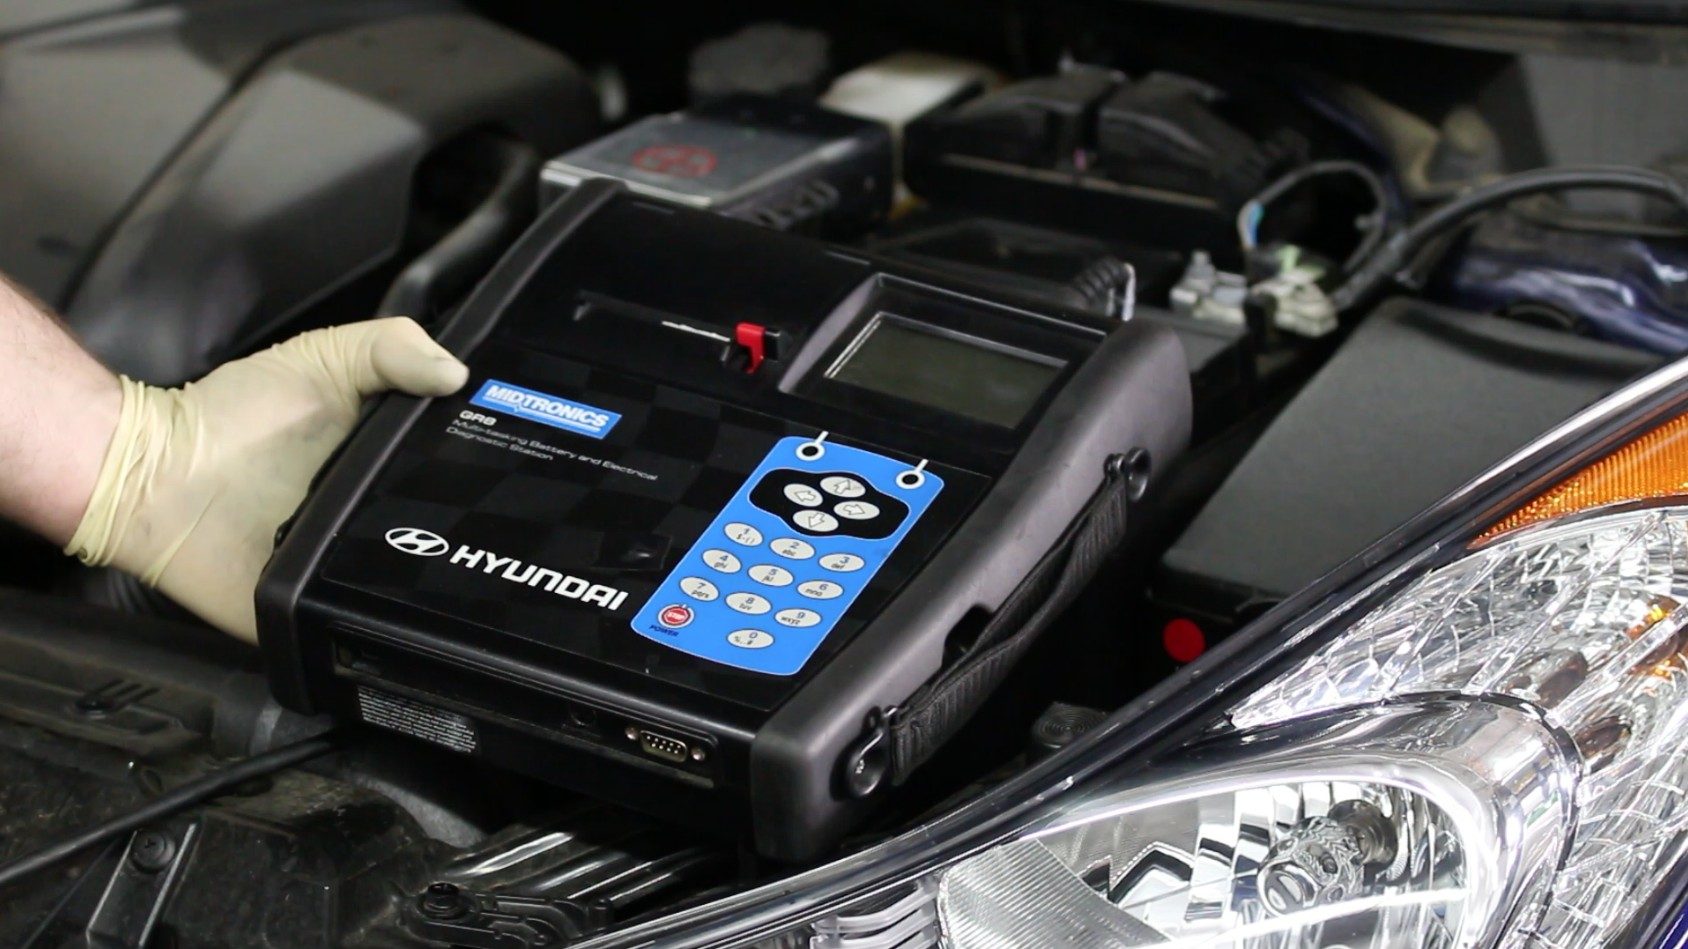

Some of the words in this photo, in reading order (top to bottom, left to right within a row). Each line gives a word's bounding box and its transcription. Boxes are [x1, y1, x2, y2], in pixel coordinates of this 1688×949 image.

[485, 385, 609, 428] MIDTRONICS
[459, 410, 497, 426] GR8
[445, 426, 508, 449] Diagnostic
[509, 443, 554, 460] Station
[452, 419, 528, 446] Multi-tasking
[529, 439, 577, 459] Battery
[578, 454, 601, 465] and
[602, 460, 658, 481] Electrical
[840, 556, 850, 564] 3
[770, 568, 779, 576] 5
[450, 545, 629, 611] HYUNDAI
[818, 583, 829, 591] 6
[805, 588, 823, 597] mno
[797, 611, 806, 619] 9
[649, 625, 679, 637] POWER
[748, 631, 758, 639] 0
